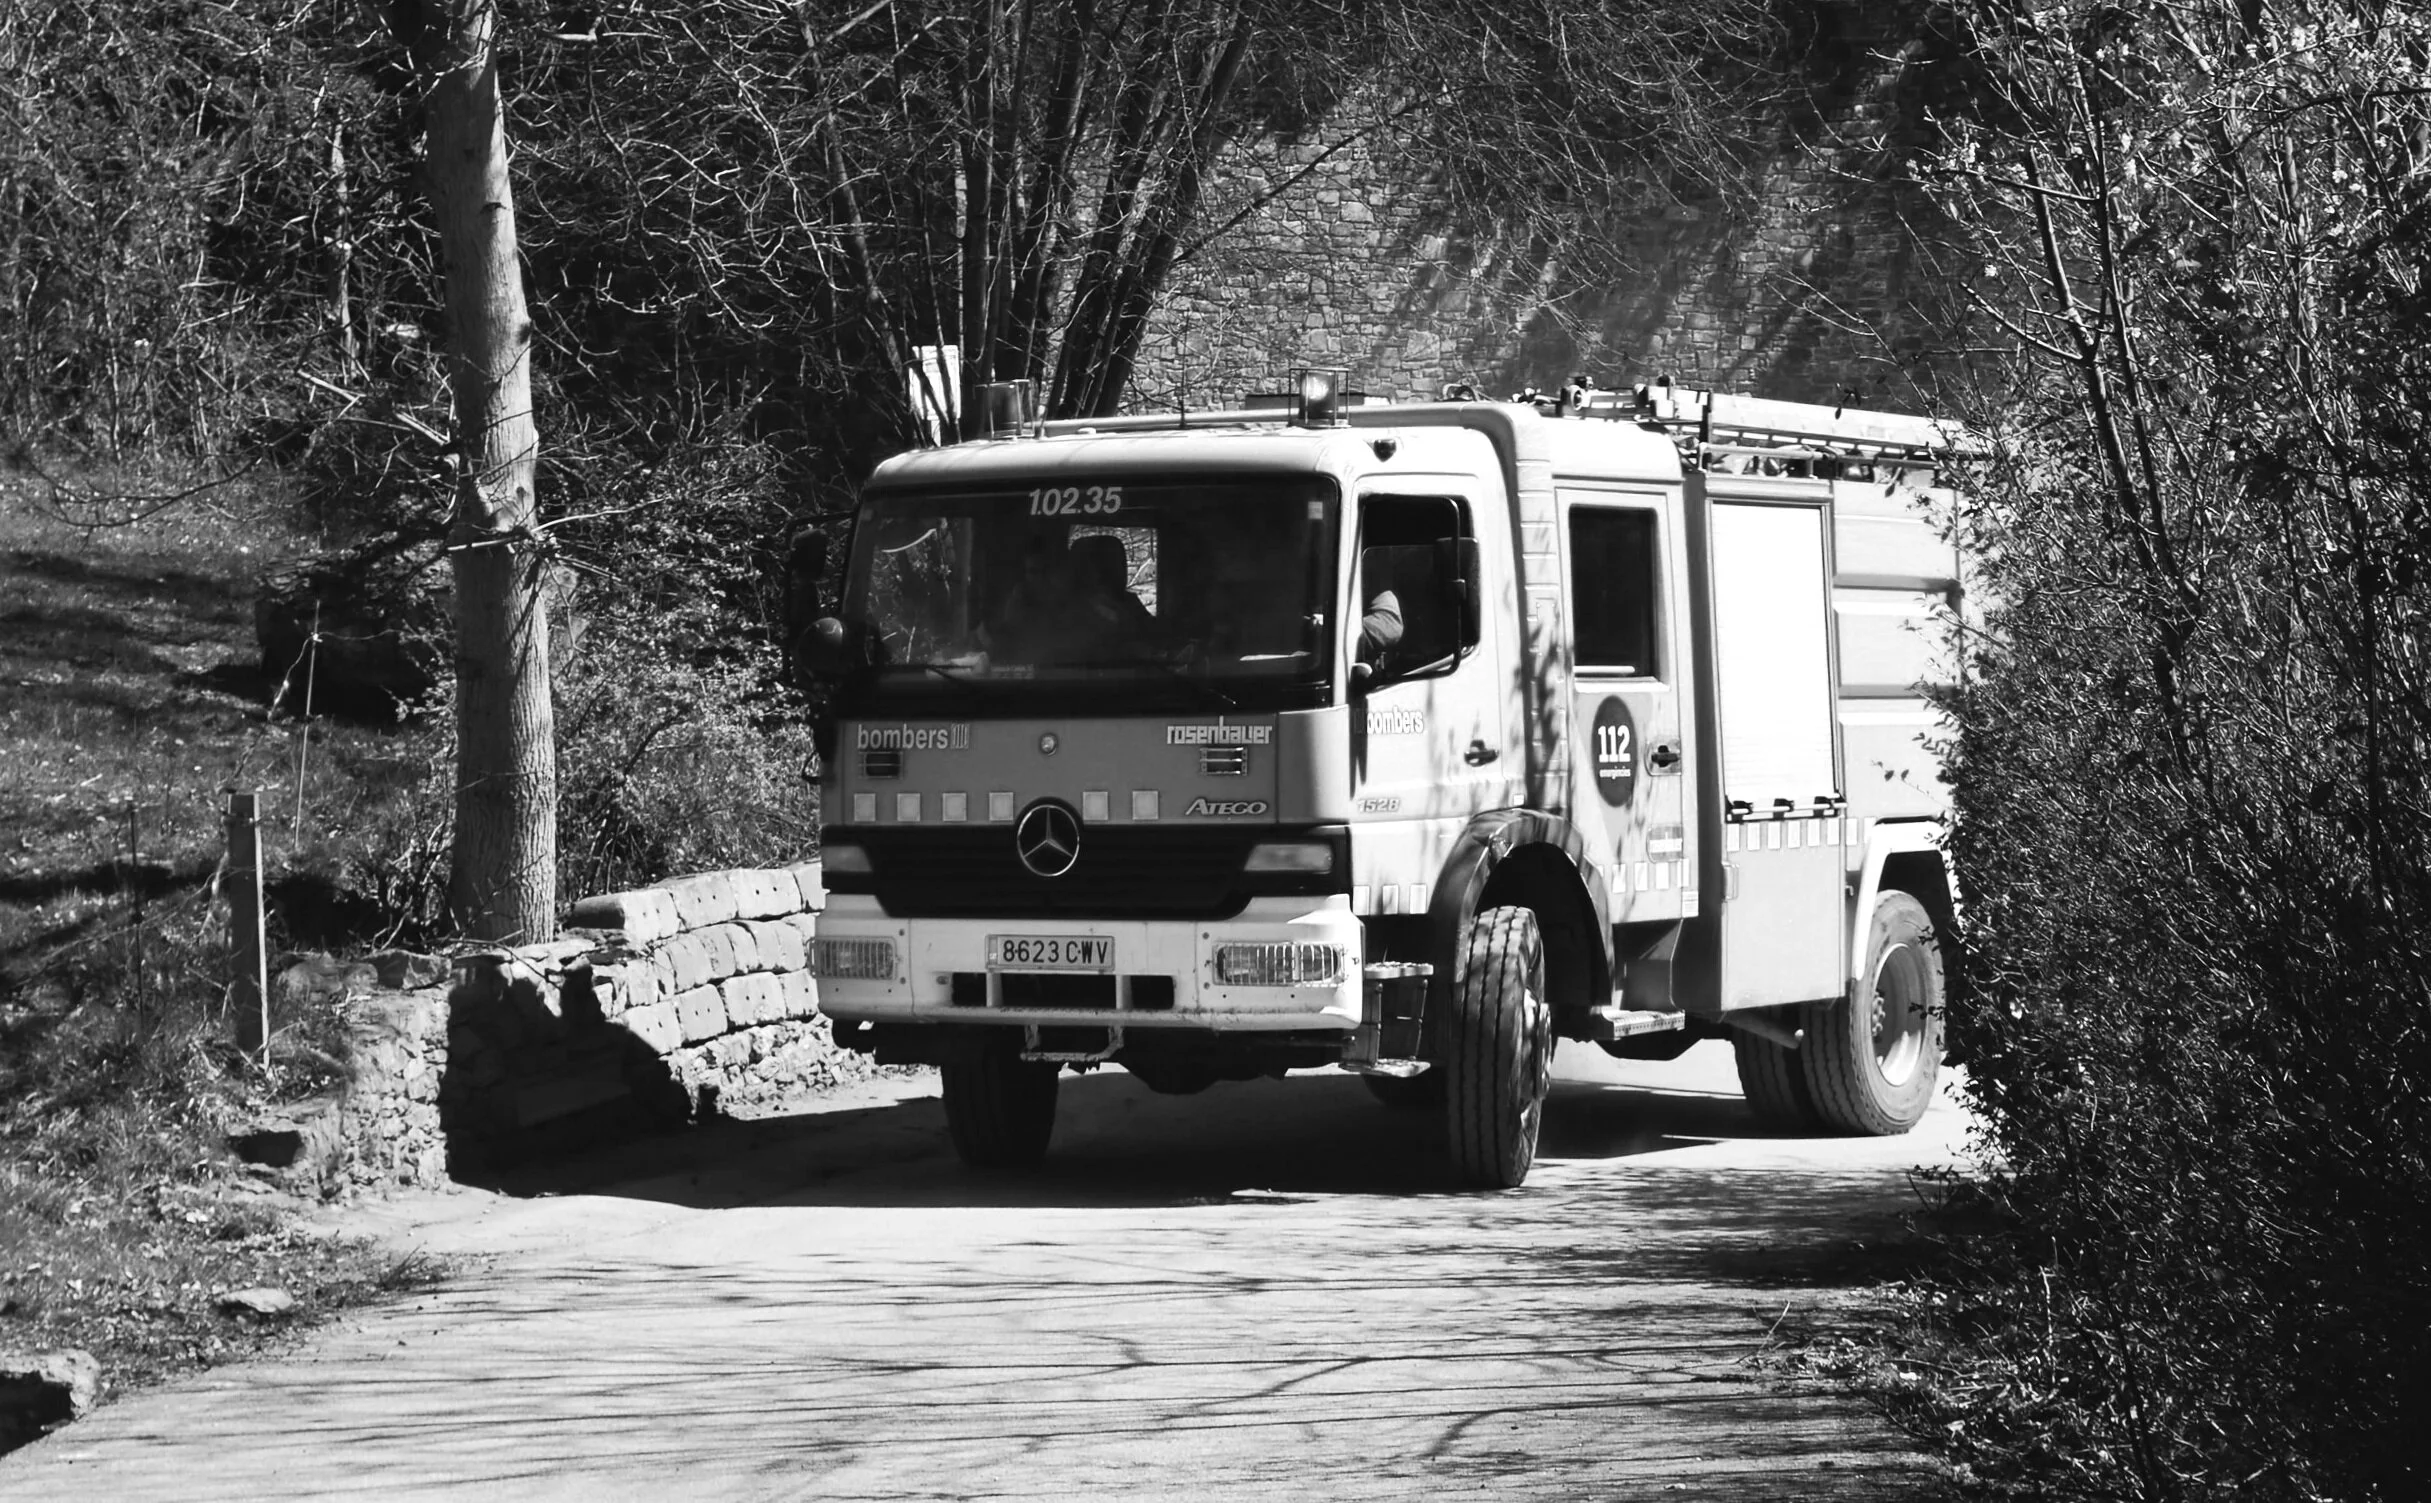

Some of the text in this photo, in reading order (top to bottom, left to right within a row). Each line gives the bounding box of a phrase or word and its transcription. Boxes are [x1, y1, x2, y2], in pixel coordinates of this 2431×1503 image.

[858, 723, 949, 750] bombers
[1167, 715, 1273, 745] rosenbauer
[1598, 725, 1631, 763] 112
[1003, 940, 1108, 965] 8623 CWV
